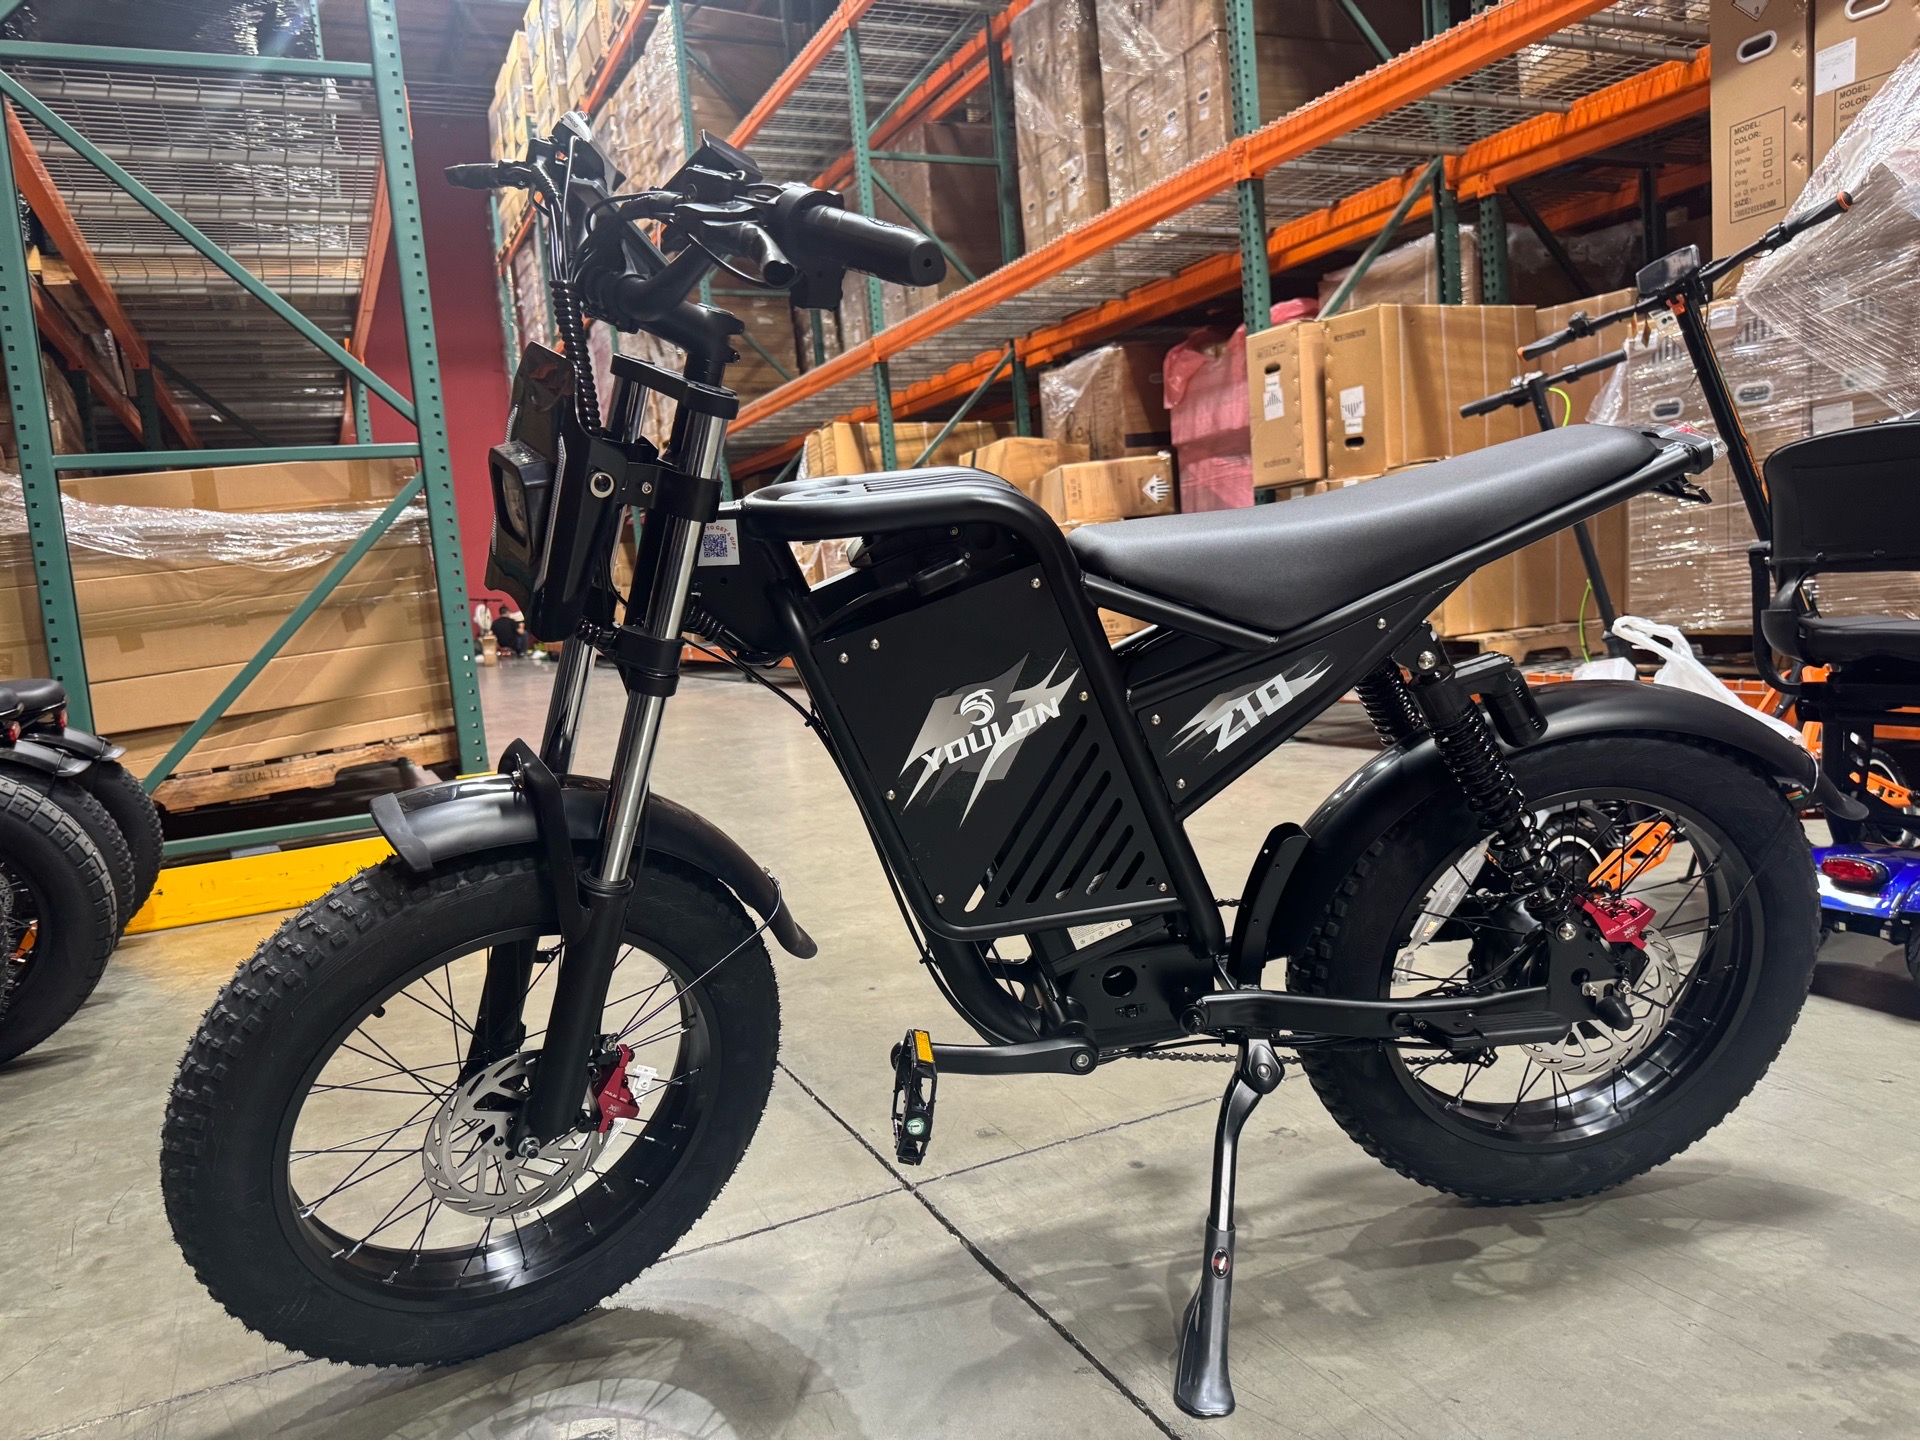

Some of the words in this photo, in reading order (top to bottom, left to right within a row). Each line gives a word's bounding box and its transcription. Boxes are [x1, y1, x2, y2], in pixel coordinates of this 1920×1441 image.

[1839, 84, 1871, 99] MODEL:
[1839, 95, 1871, 111] COLOR:
[1733, 120, 1761, 135] MODEL:
[1733, 131, 1761, 146] COLOR:
[1205, 673, 1294, 753] Z10
[921, 696, 1062, 772] YOULON
